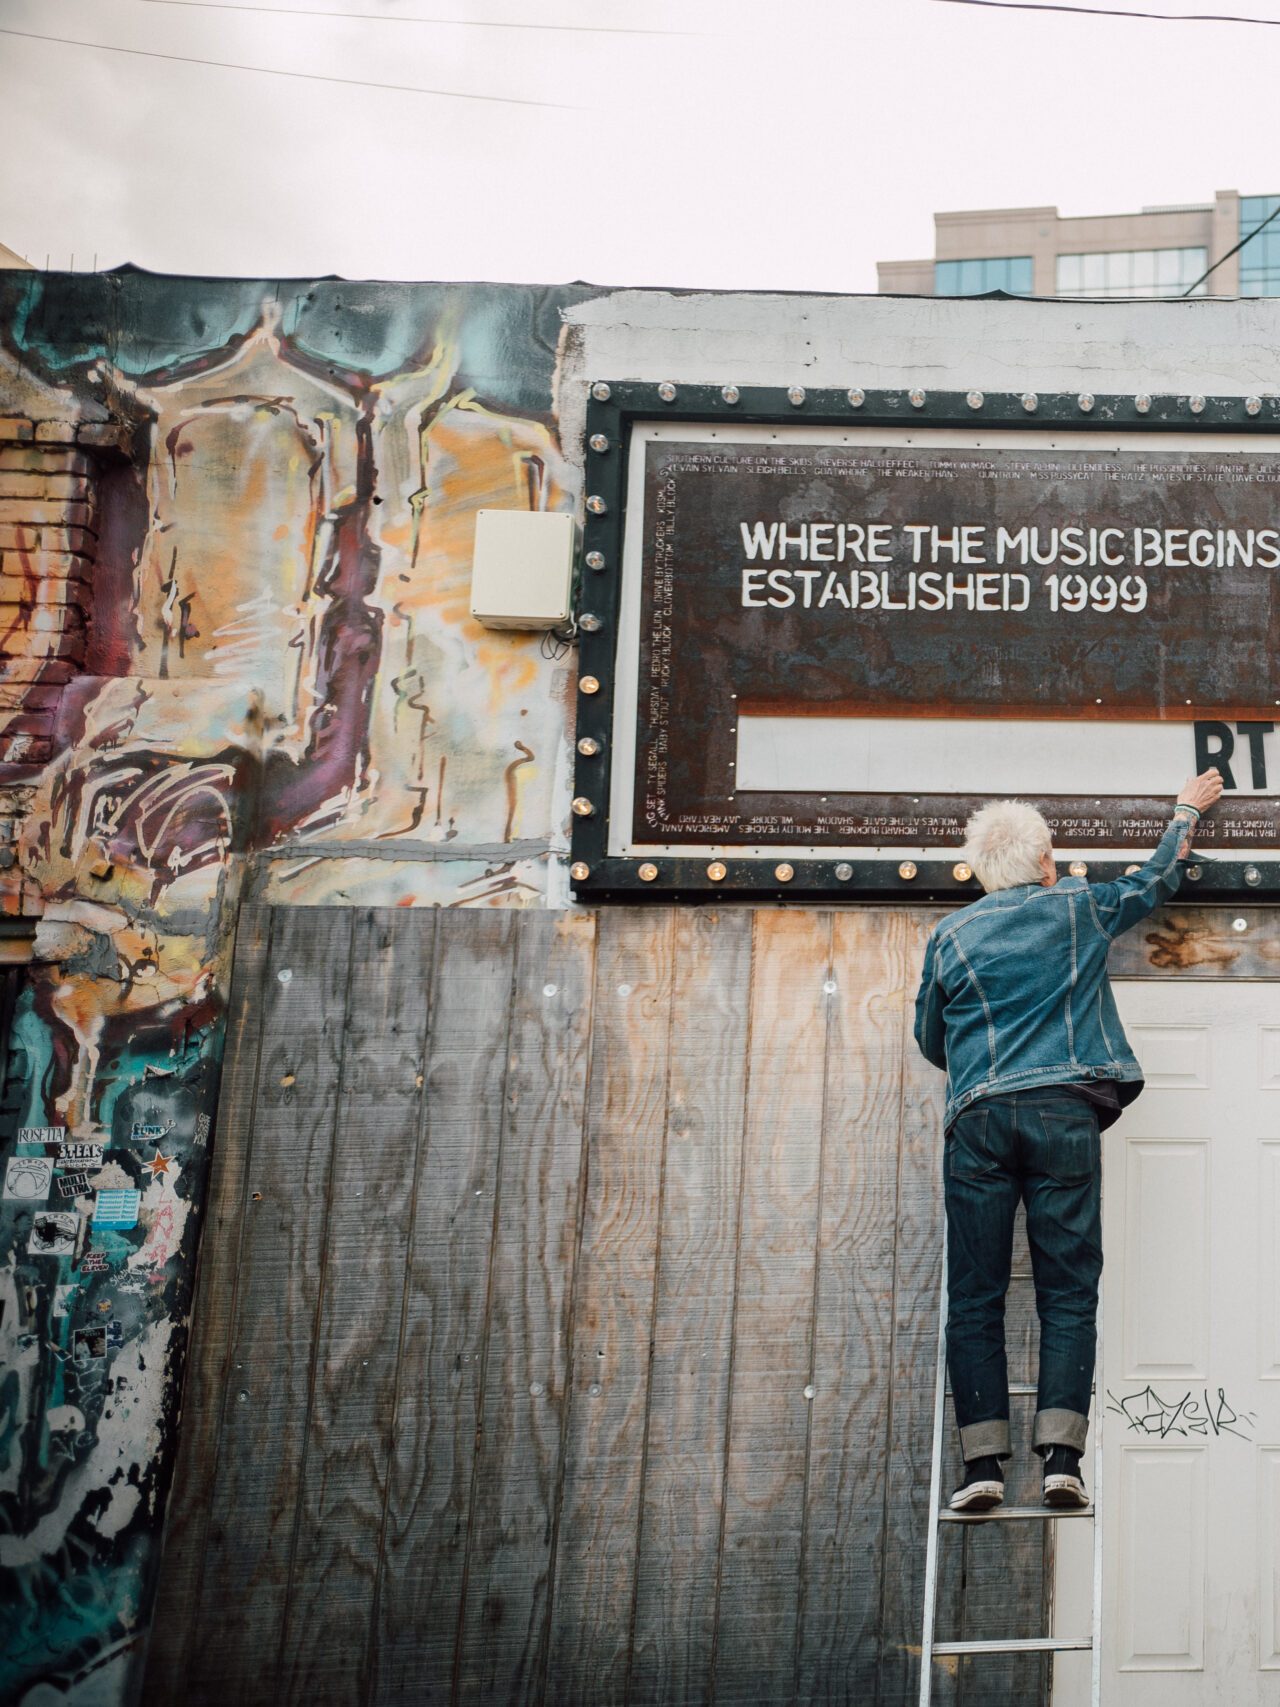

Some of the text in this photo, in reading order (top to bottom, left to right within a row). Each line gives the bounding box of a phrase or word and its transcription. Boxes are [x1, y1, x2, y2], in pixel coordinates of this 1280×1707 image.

[741, 522, 892, 563] WHERE
[903, 526, 986, 564] THE
[997, 527, 1124, 566] MUSIC
[742, 570, 1148, 612] ESTABLISHED 1999
[652, 631, 661, 647] THE
[649, 685, 659, 728] THURSDAY
[648, 738, 658, 771] SEGALL
[647, 773, 656, 785] TY
[646, 793, 656, 809] SET
[20, 1128, 63, 1142] ROSETTA
[60, 1144, 99, 1158] STEAK
